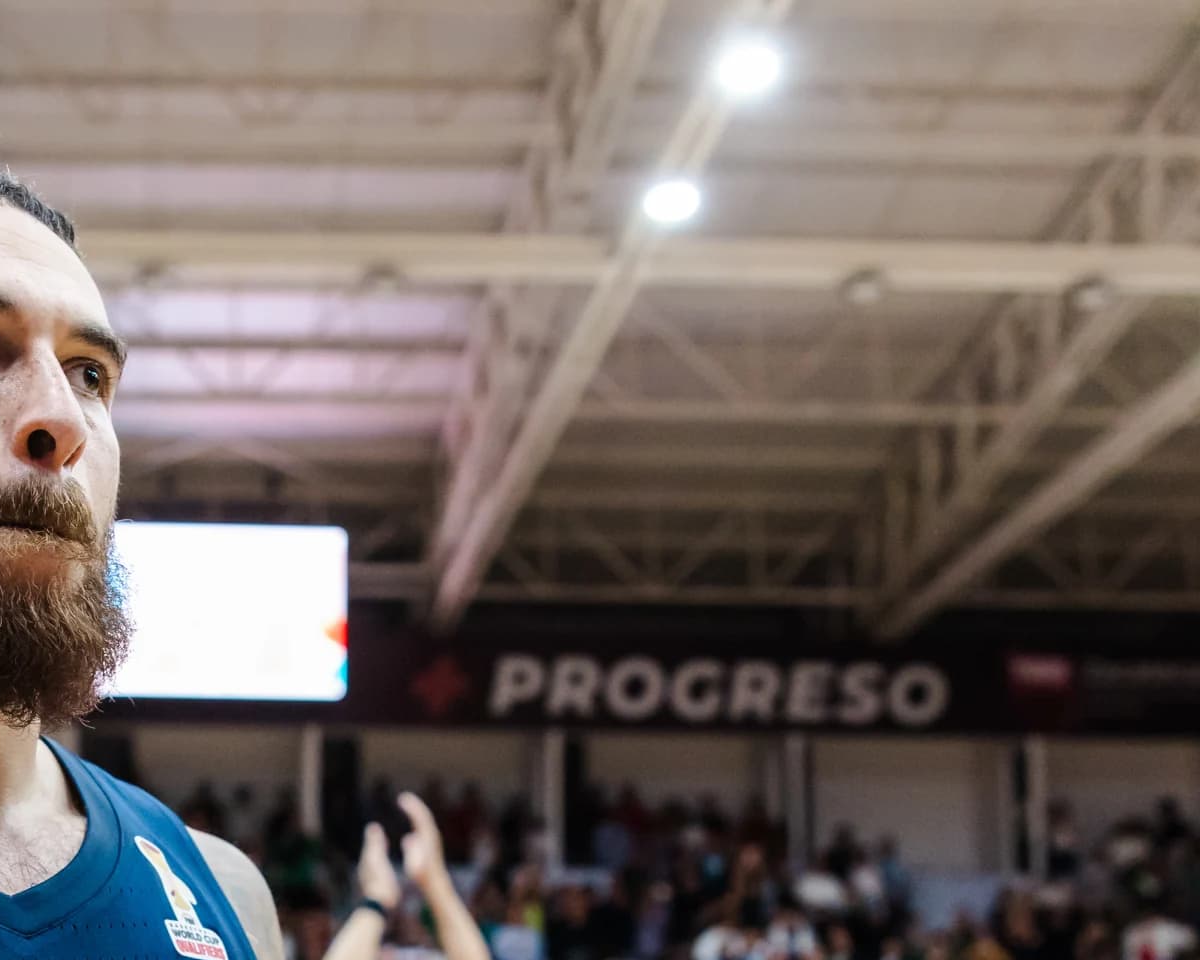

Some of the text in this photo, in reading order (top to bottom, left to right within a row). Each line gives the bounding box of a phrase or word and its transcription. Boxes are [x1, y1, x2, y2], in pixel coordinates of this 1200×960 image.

[488, 654, 950, 725] PROGRESO
[171, 928, 203, 942] WORLD
[203, 934, 220, 946] CUP
